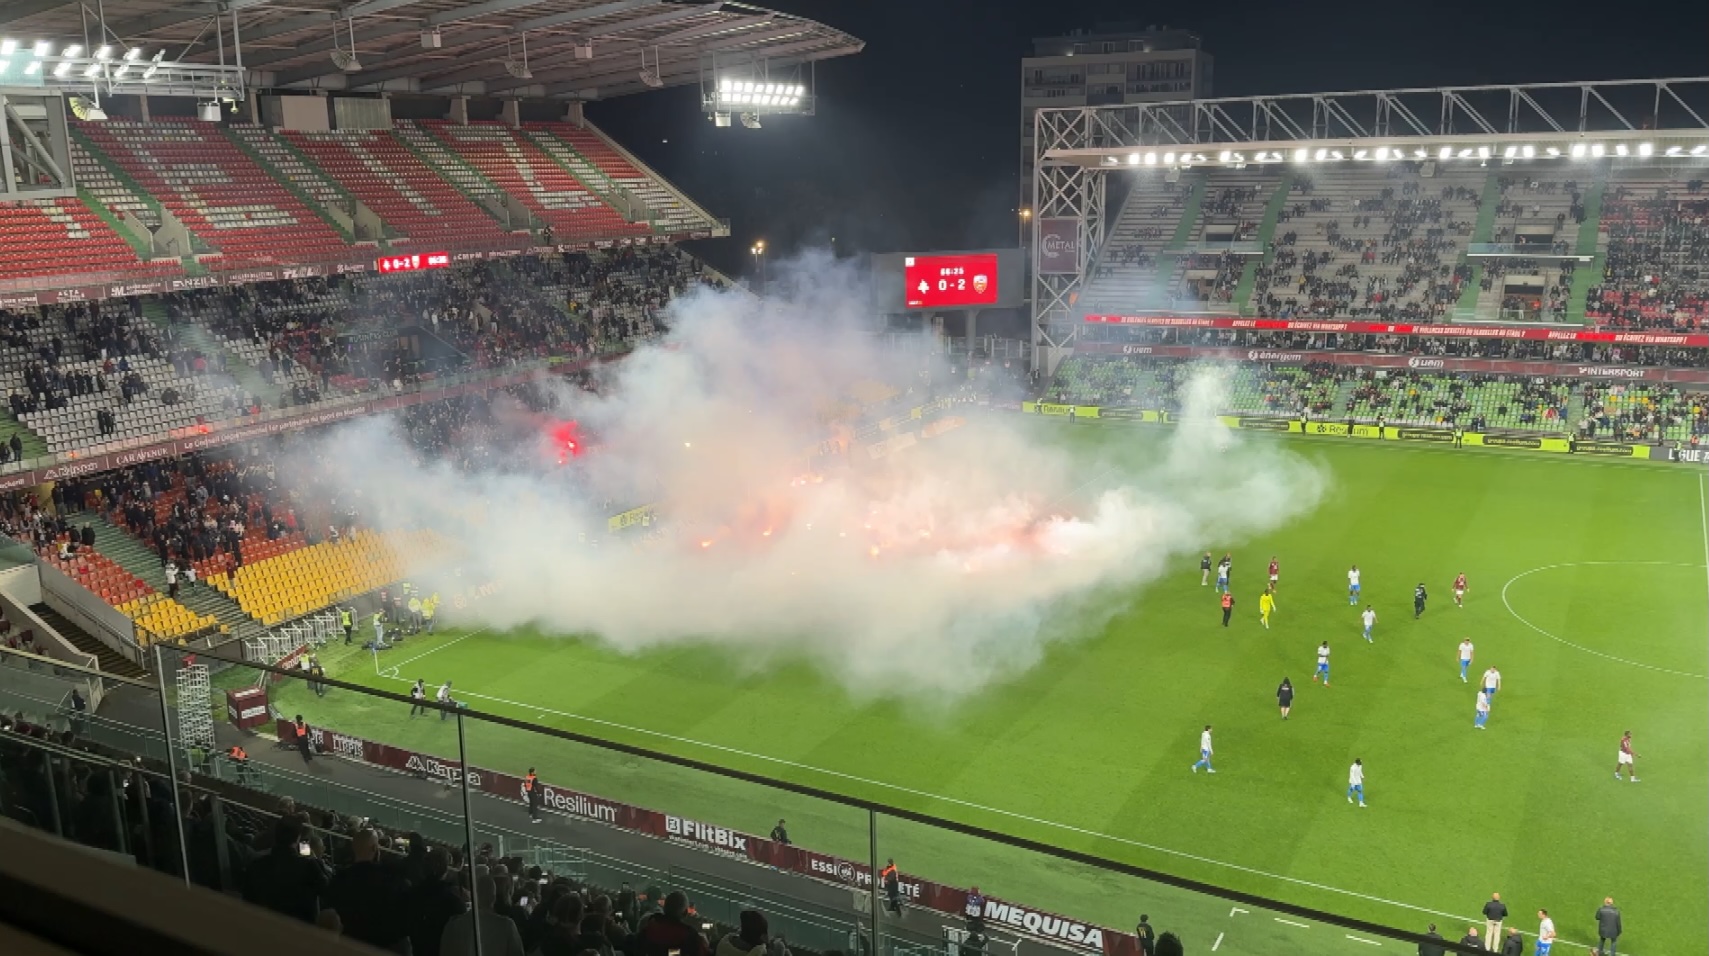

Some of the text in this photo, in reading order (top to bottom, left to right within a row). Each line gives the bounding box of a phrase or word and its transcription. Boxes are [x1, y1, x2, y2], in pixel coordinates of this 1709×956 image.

[938, 278, 947, 291] 0
[958, 278, 966, 290] 2
[1588, 367, 1644, 377] INTERSPORT
[1668, 448, 1700, 462] LGUE
[426, 760, 481, 786] Kappa
[543, 788, 617, 822] Resilium
[812, 859, 837, 876] ESSI
[984, 901, 1104, 948] MEQUISA
